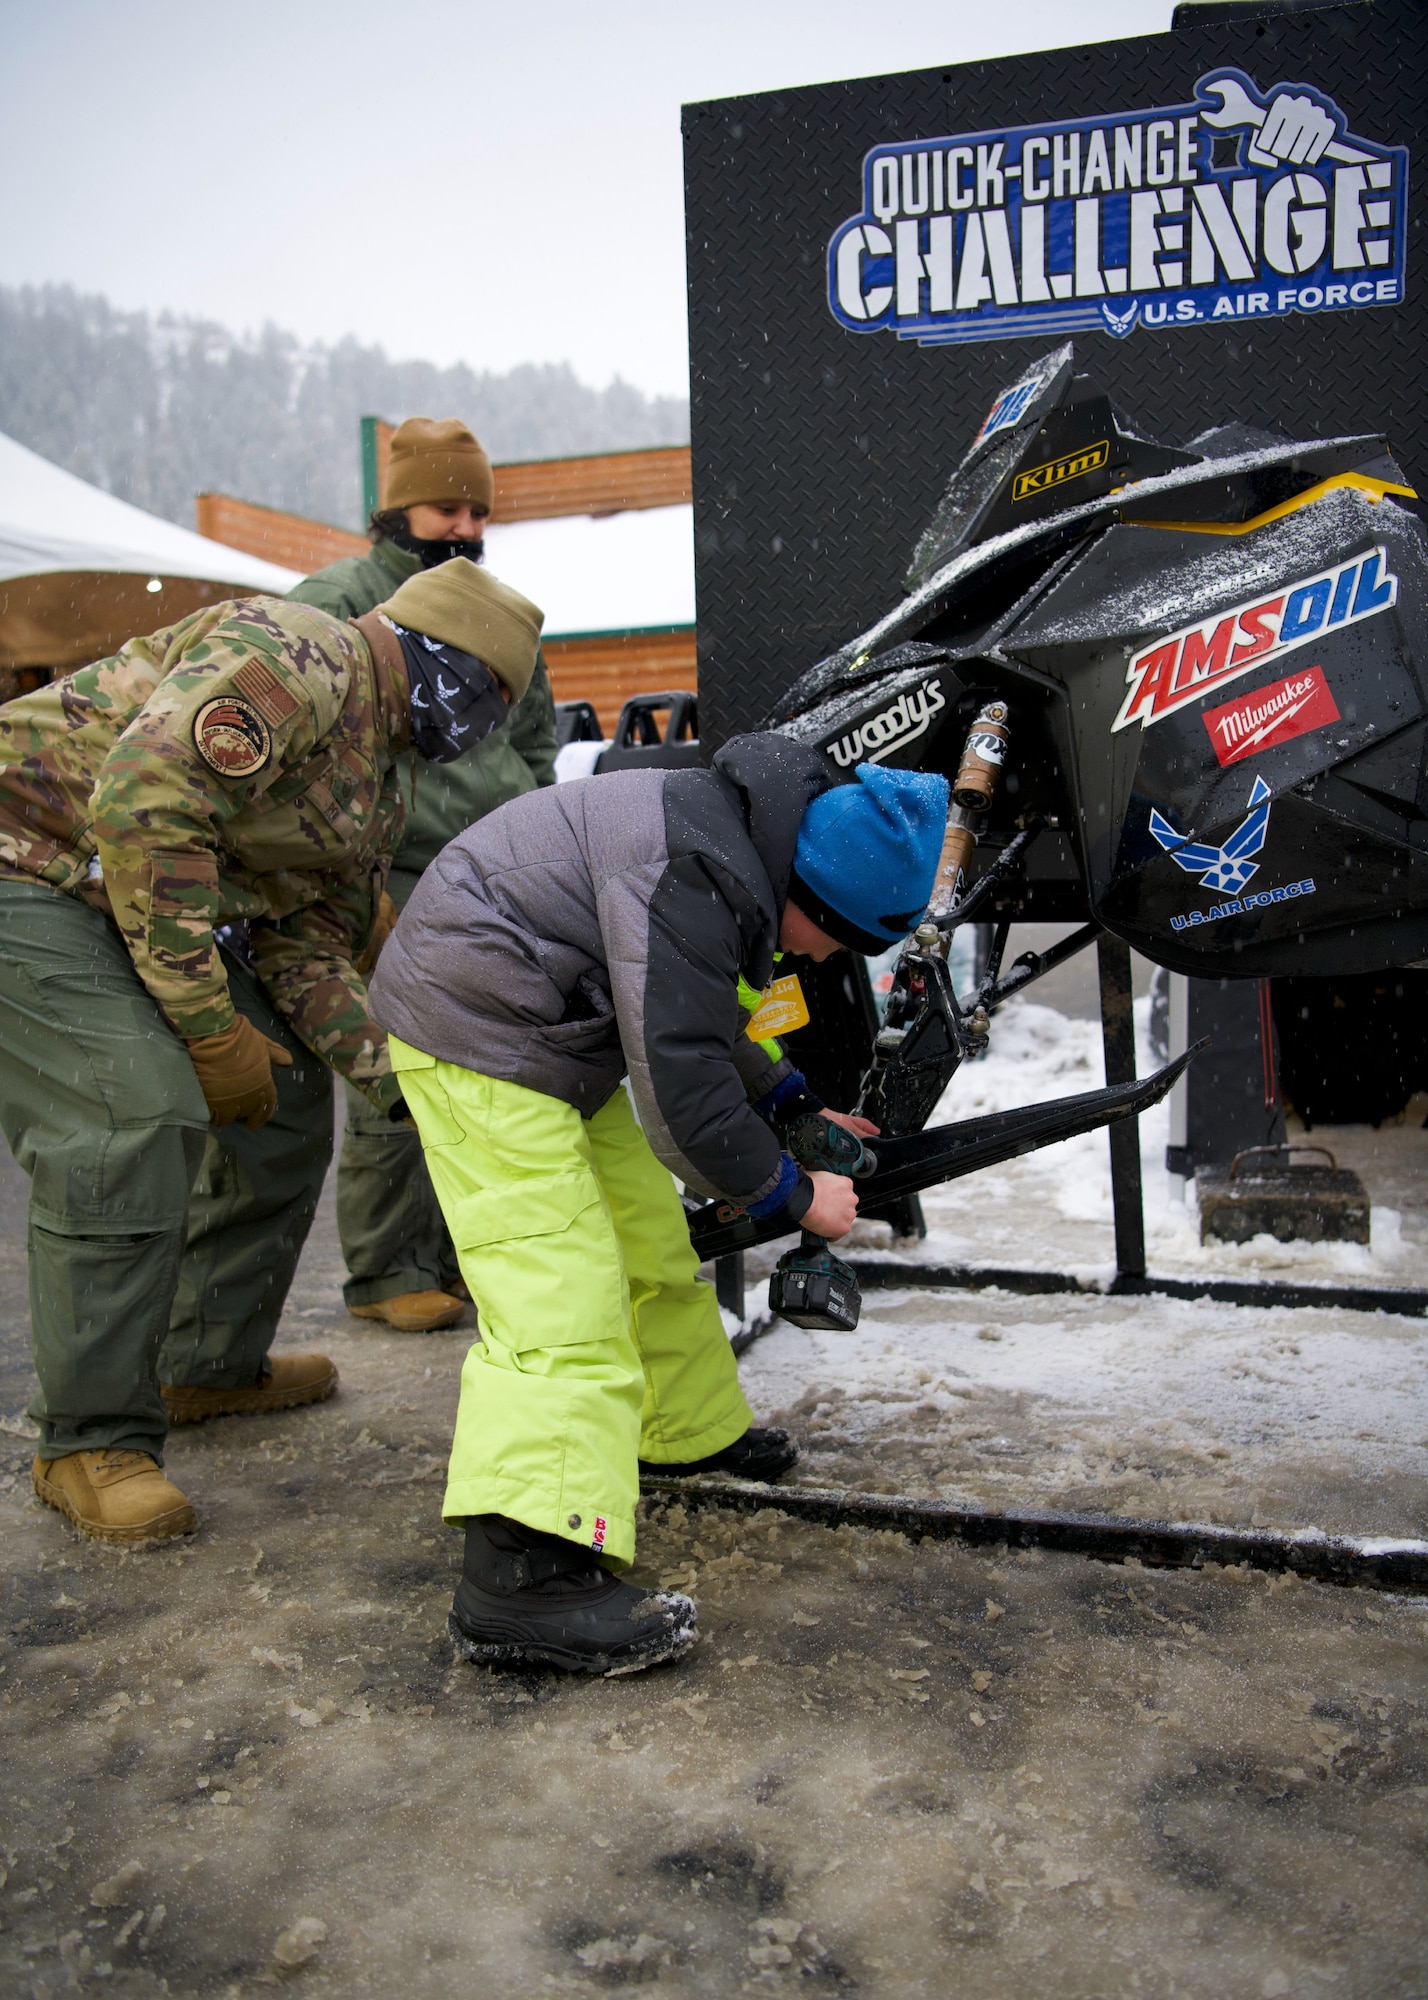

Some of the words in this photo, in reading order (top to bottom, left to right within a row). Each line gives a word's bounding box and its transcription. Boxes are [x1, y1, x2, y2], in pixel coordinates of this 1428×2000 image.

[872, 116, 1198, 225] QUICK-CHANGE
[835, 160, 1393, 320] CHALLENGE
[1144, 299, 1204, 323] U.S.
[1212, 292, 1270, 317] AIR
[1277, 278, 1398, 310] FORCE
[1017, 450, 1102, 496] Klim
[1122, 550, 1394, 721] AMSOIL
[1214, 676, 1316, 748] Milwaukee
[1208, 900, 1245, 921] AIR
[1243, 877, 1317, 911] FORCE
